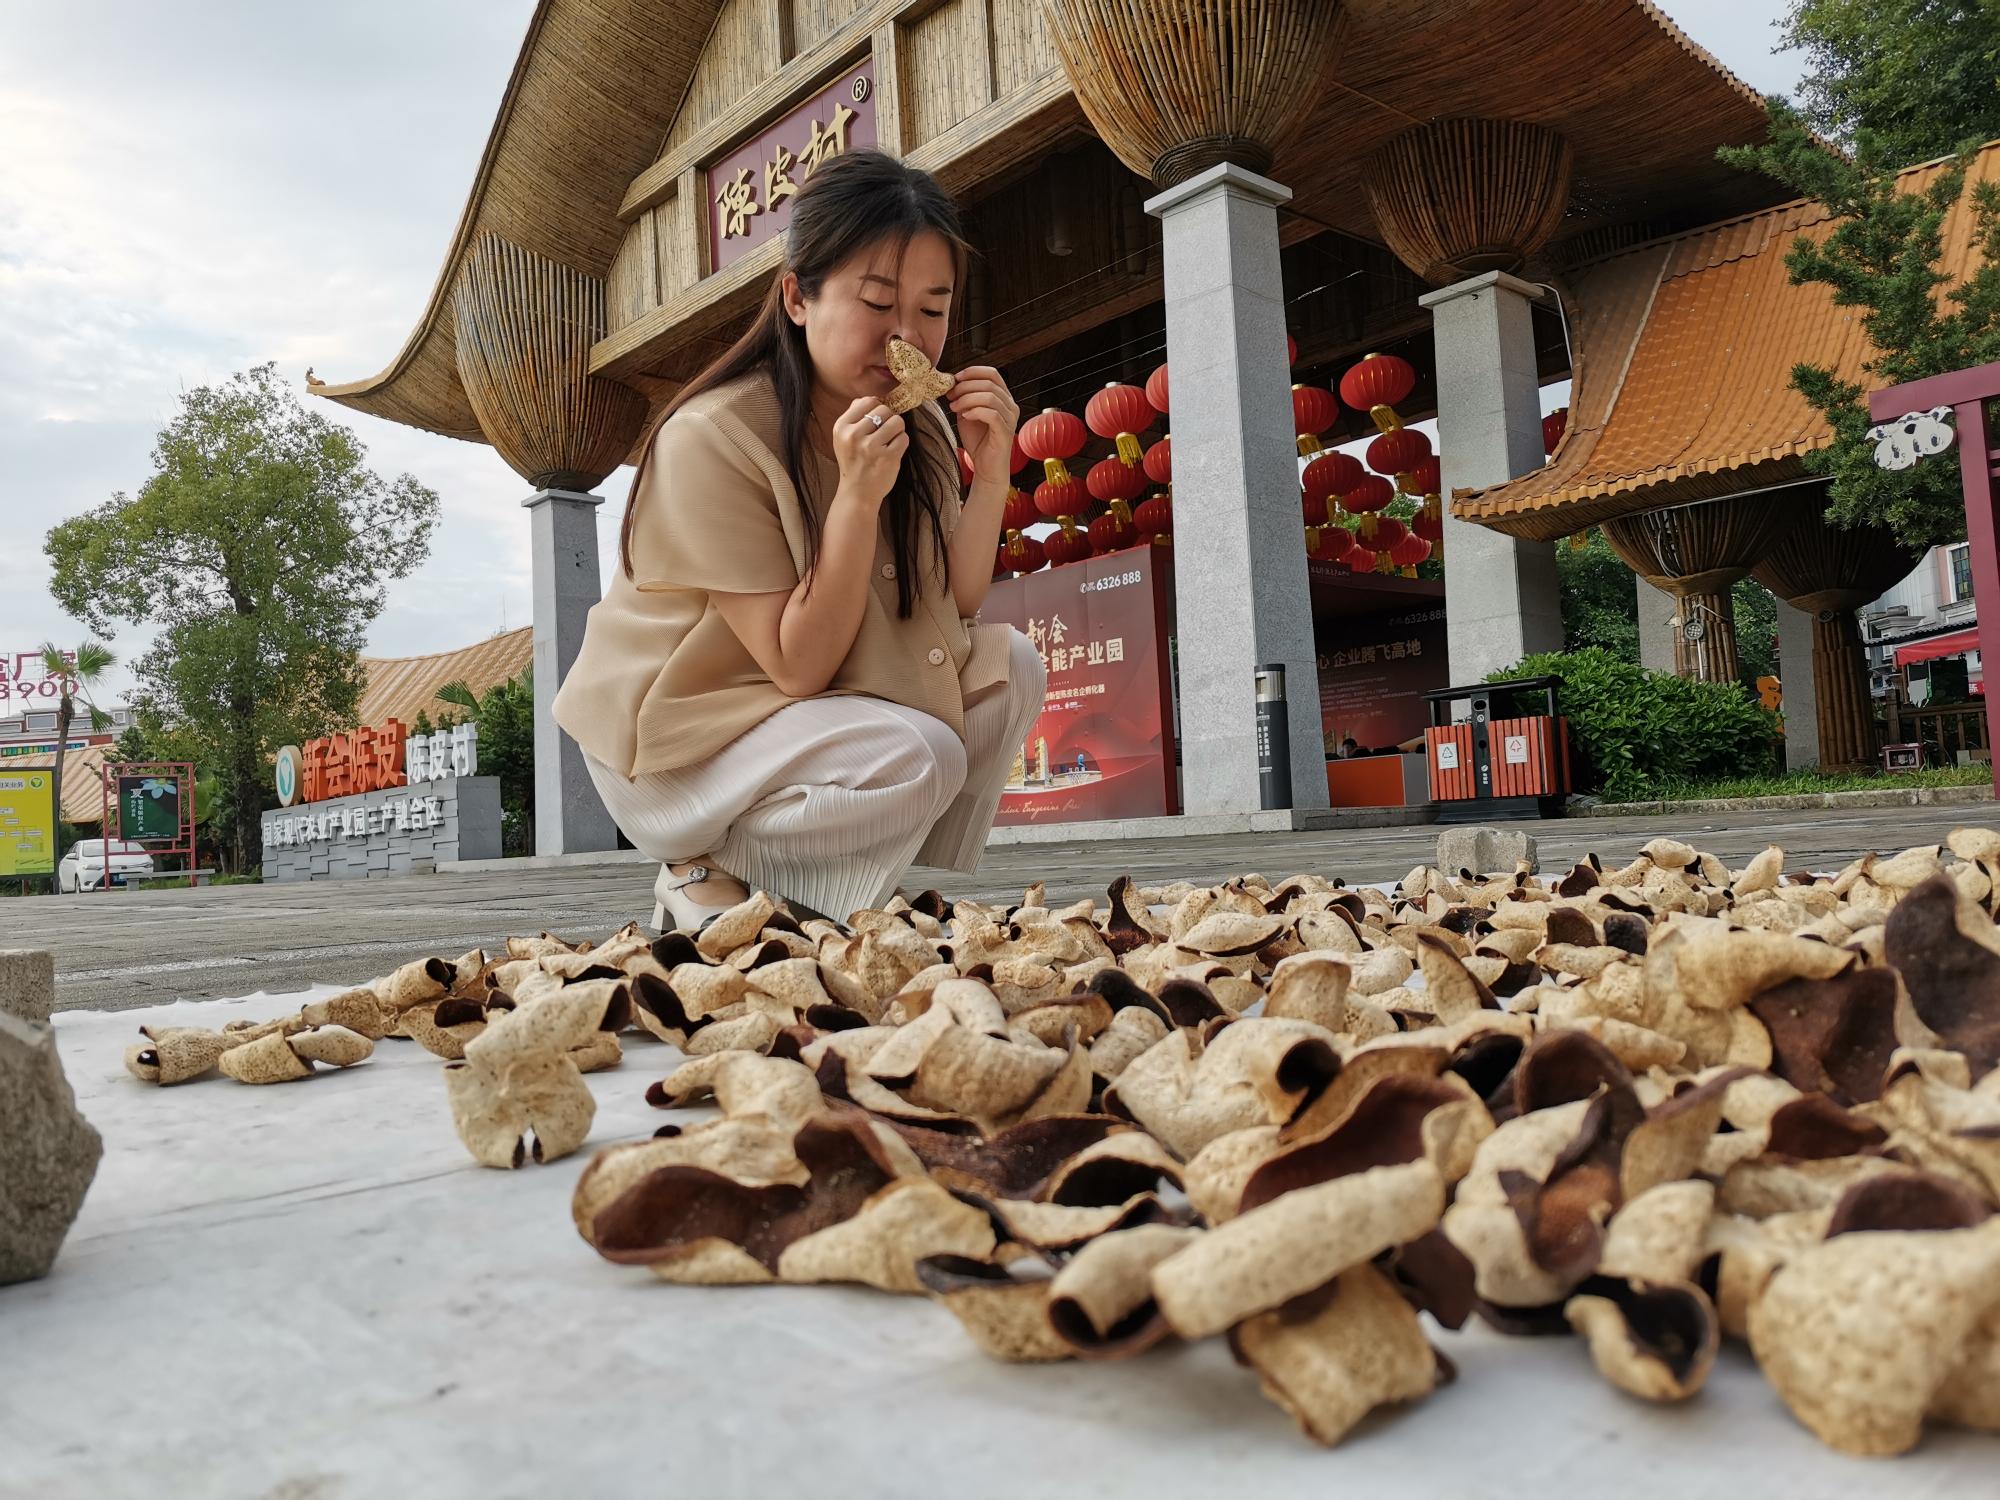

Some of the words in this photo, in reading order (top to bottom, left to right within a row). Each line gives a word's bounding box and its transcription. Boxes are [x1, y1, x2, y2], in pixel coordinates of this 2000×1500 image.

[1096, 575, 1121, 591] 6326
[1122, 570, 1141, 585] 888
[302, 718, 407, 802] 新会陈皮
[406, 723, 478, 786] 陈皮村
